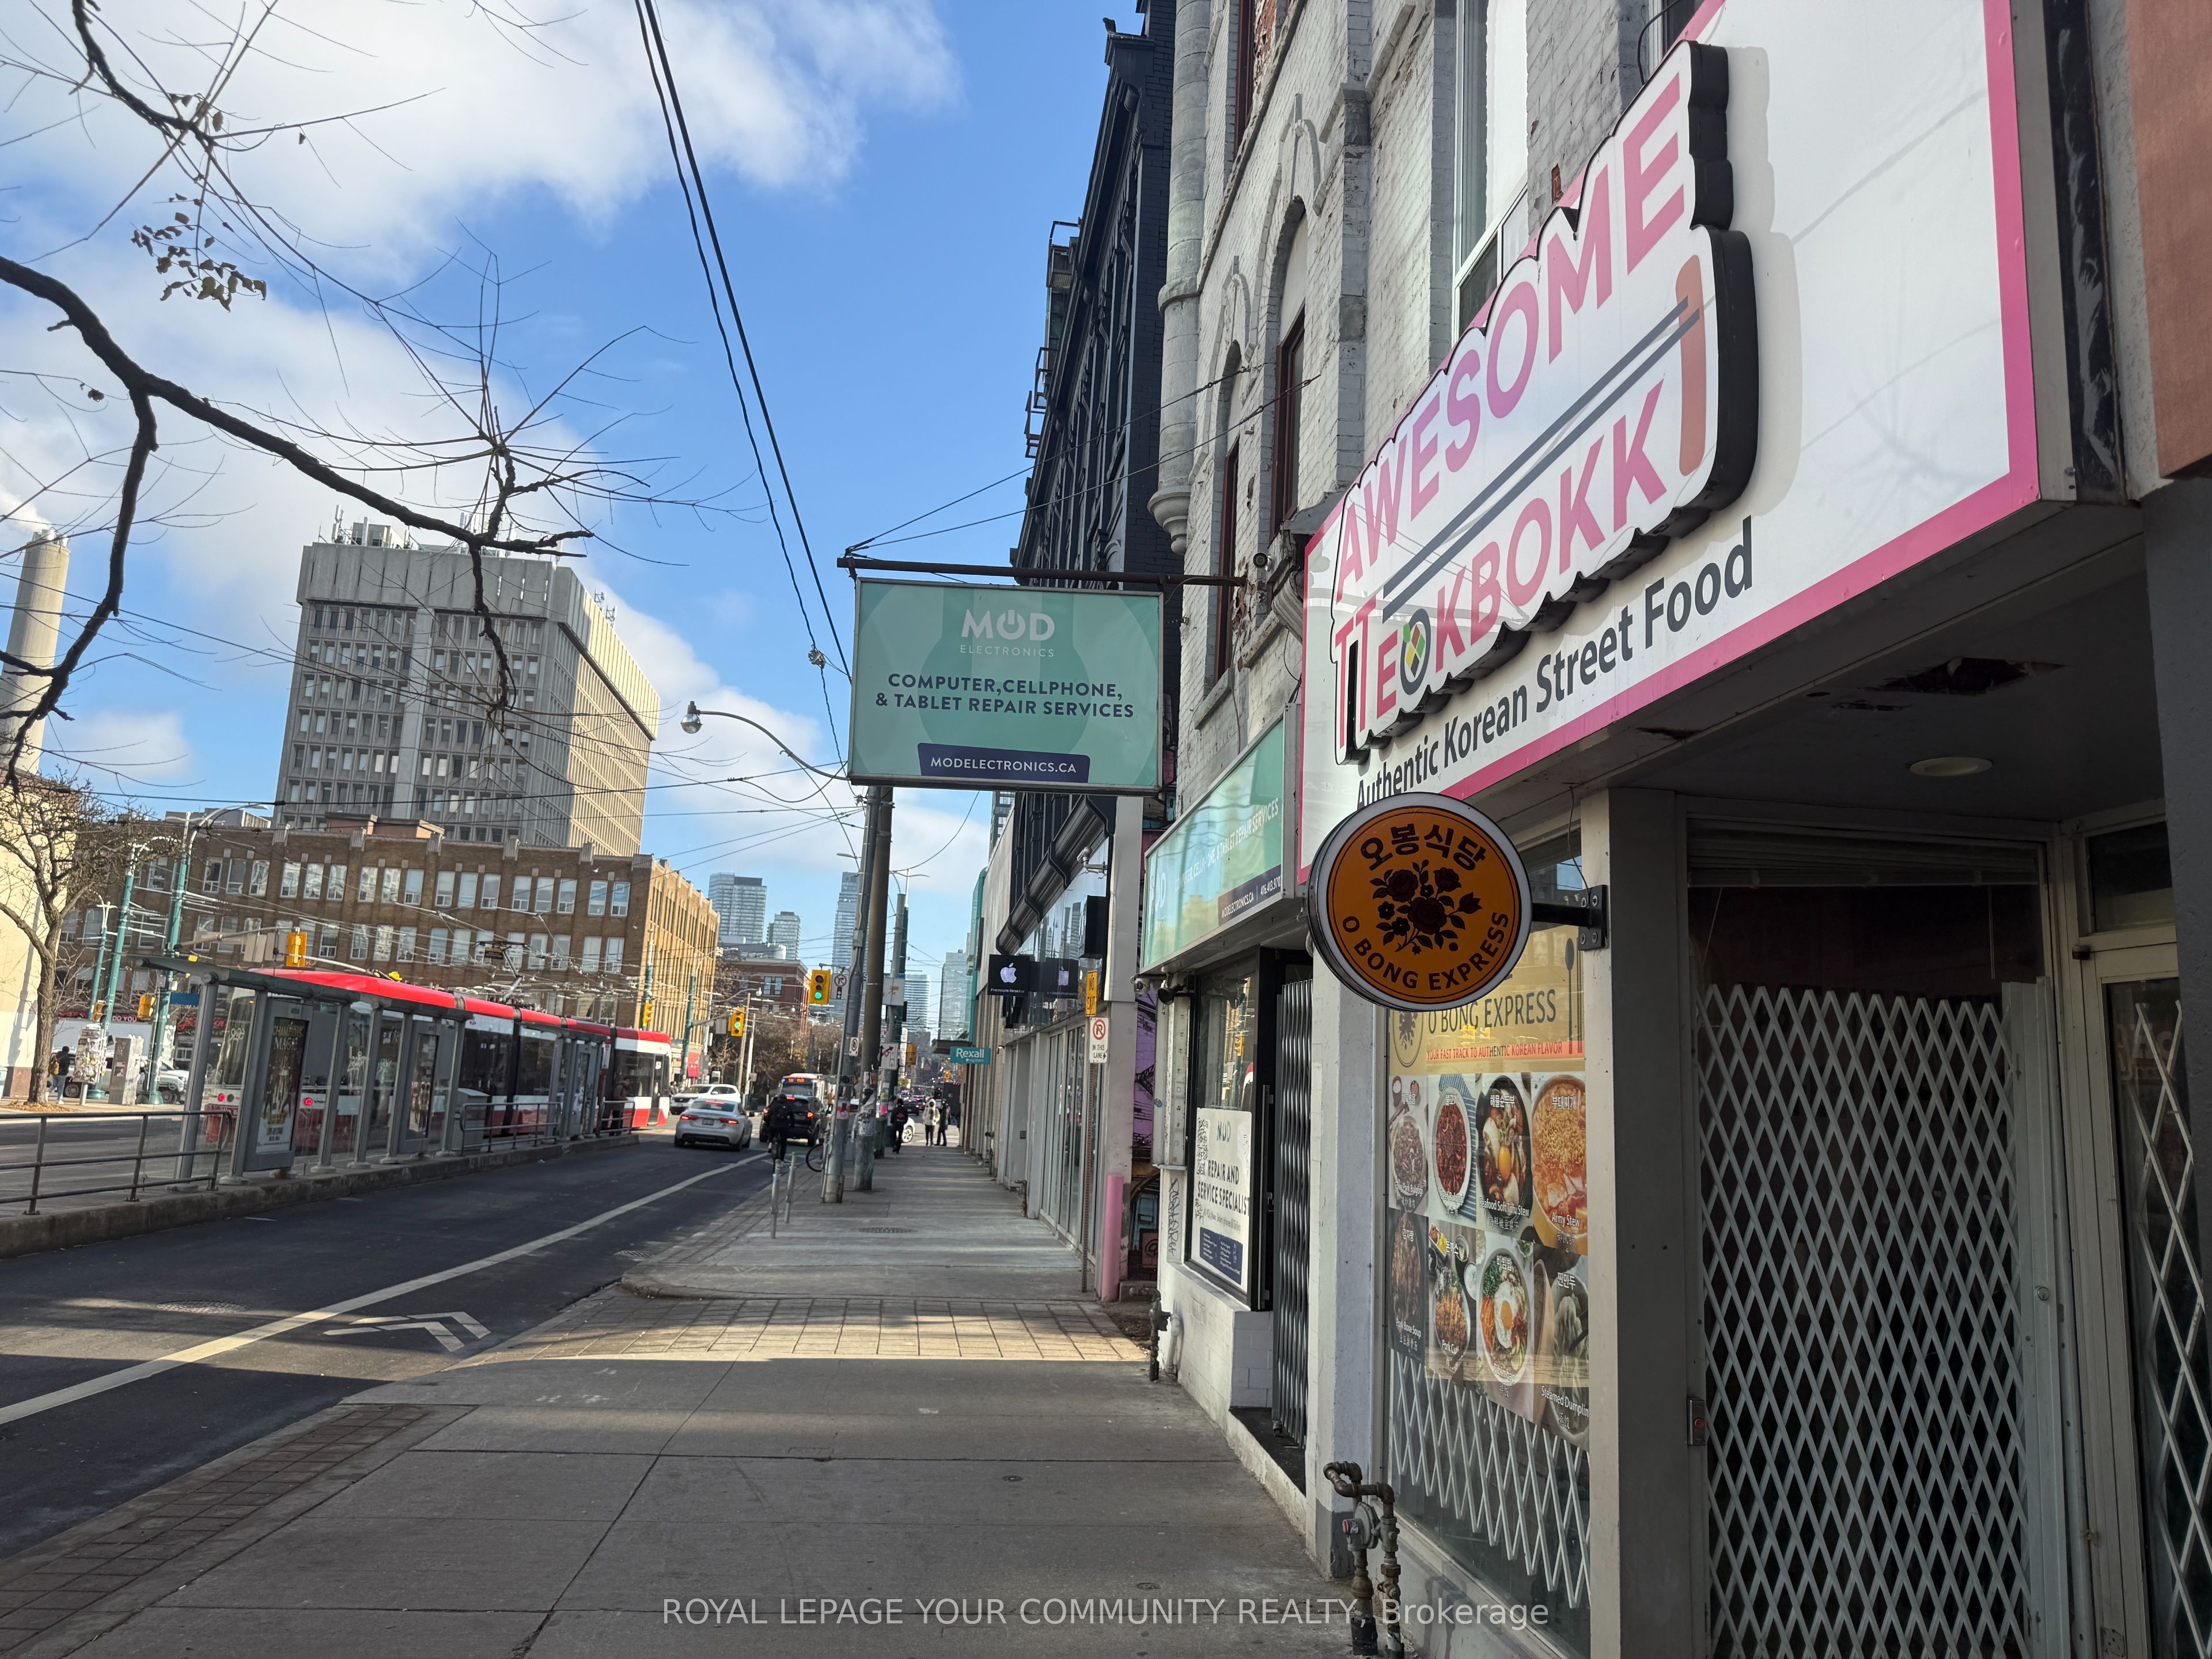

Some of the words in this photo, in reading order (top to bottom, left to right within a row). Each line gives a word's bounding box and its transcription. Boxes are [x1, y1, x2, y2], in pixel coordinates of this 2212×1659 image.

[1337, 72, 1685, 604] AWESOME
[961, 608, 1055, 641] MOD
[960, 645, 1055, 658] ELECTRONICS
[1357, 735, 1438, 811] Authentic
[1444, 684, 1527, 768] Korean
[1536, 604, 1634, 714] Street
[1645, 516, 1752, 649] Food
[876, 693, 888, 706] &
[895, 694, 961, 711] TABLET
[969, 698, 1036, 714] REPAIR
[1043, 702, 1134, 718] SERVICES
[930, 756, 1077, 774] MODELECTRONICS.CA
[1220, 834, 1235, 857] TABLET
[1236, 819, 1252, 846] REPAIR
[1252, 798, 1279, 832] SERVICES
[1360, 823, 1486, 872] 오봉식당
[1222, 891, 1253, 918] MODELECTRONICS.CA
[1260, 876, 1281, 896] 416.413.970
[1342, 915, 1360, 933] O
[1354, 938, 1419, 989] BONG
[1429, 912, 1509, 991] EXPRESS
[1089, 976, 1094, 991] NO
[1441, 1001, 1478, 1032] BONG
[1484, 989, 1555, 1028] EXPRESS
[956, 1048, 984, 1058] Rexall
[1427, 1049, 1440, 1060] YOUR
[1441, 1048, 1451, 1059] FAST
[1453, 1047, 1469, 1058] TRACK
[1471, 1047, 1477, 1058] TO
[1479, 1045, 1510, 1057] AUTHENTIC
[1512, 1043, 1536, 1055] KOREAN
[1537, 1041, 1562, 1054] FLAVOR
[1207, 1160, 1226, 1181] REPAIR
[1226, 1165, 1239, 1185] AND
[1198, 1181, 1218, 1205] SERVICE
[1479, 1198, 1497, 1210] Seafood
[1497, 1200, 1507, 1213] Soft
[1507, 1203, 1517, 1214] Tofu
[1518, 1205, 1529, 1217] Stew
[1552, 1211, 1566, 1227] Army
[1566, 1214, 1580, 1228] Stew
[1558, 1272, 1576, 1290] 찐만두
[1541, 1385, 1564, 1406] Steamed
[1565, 1396, 1589, 1418] Dumplin
